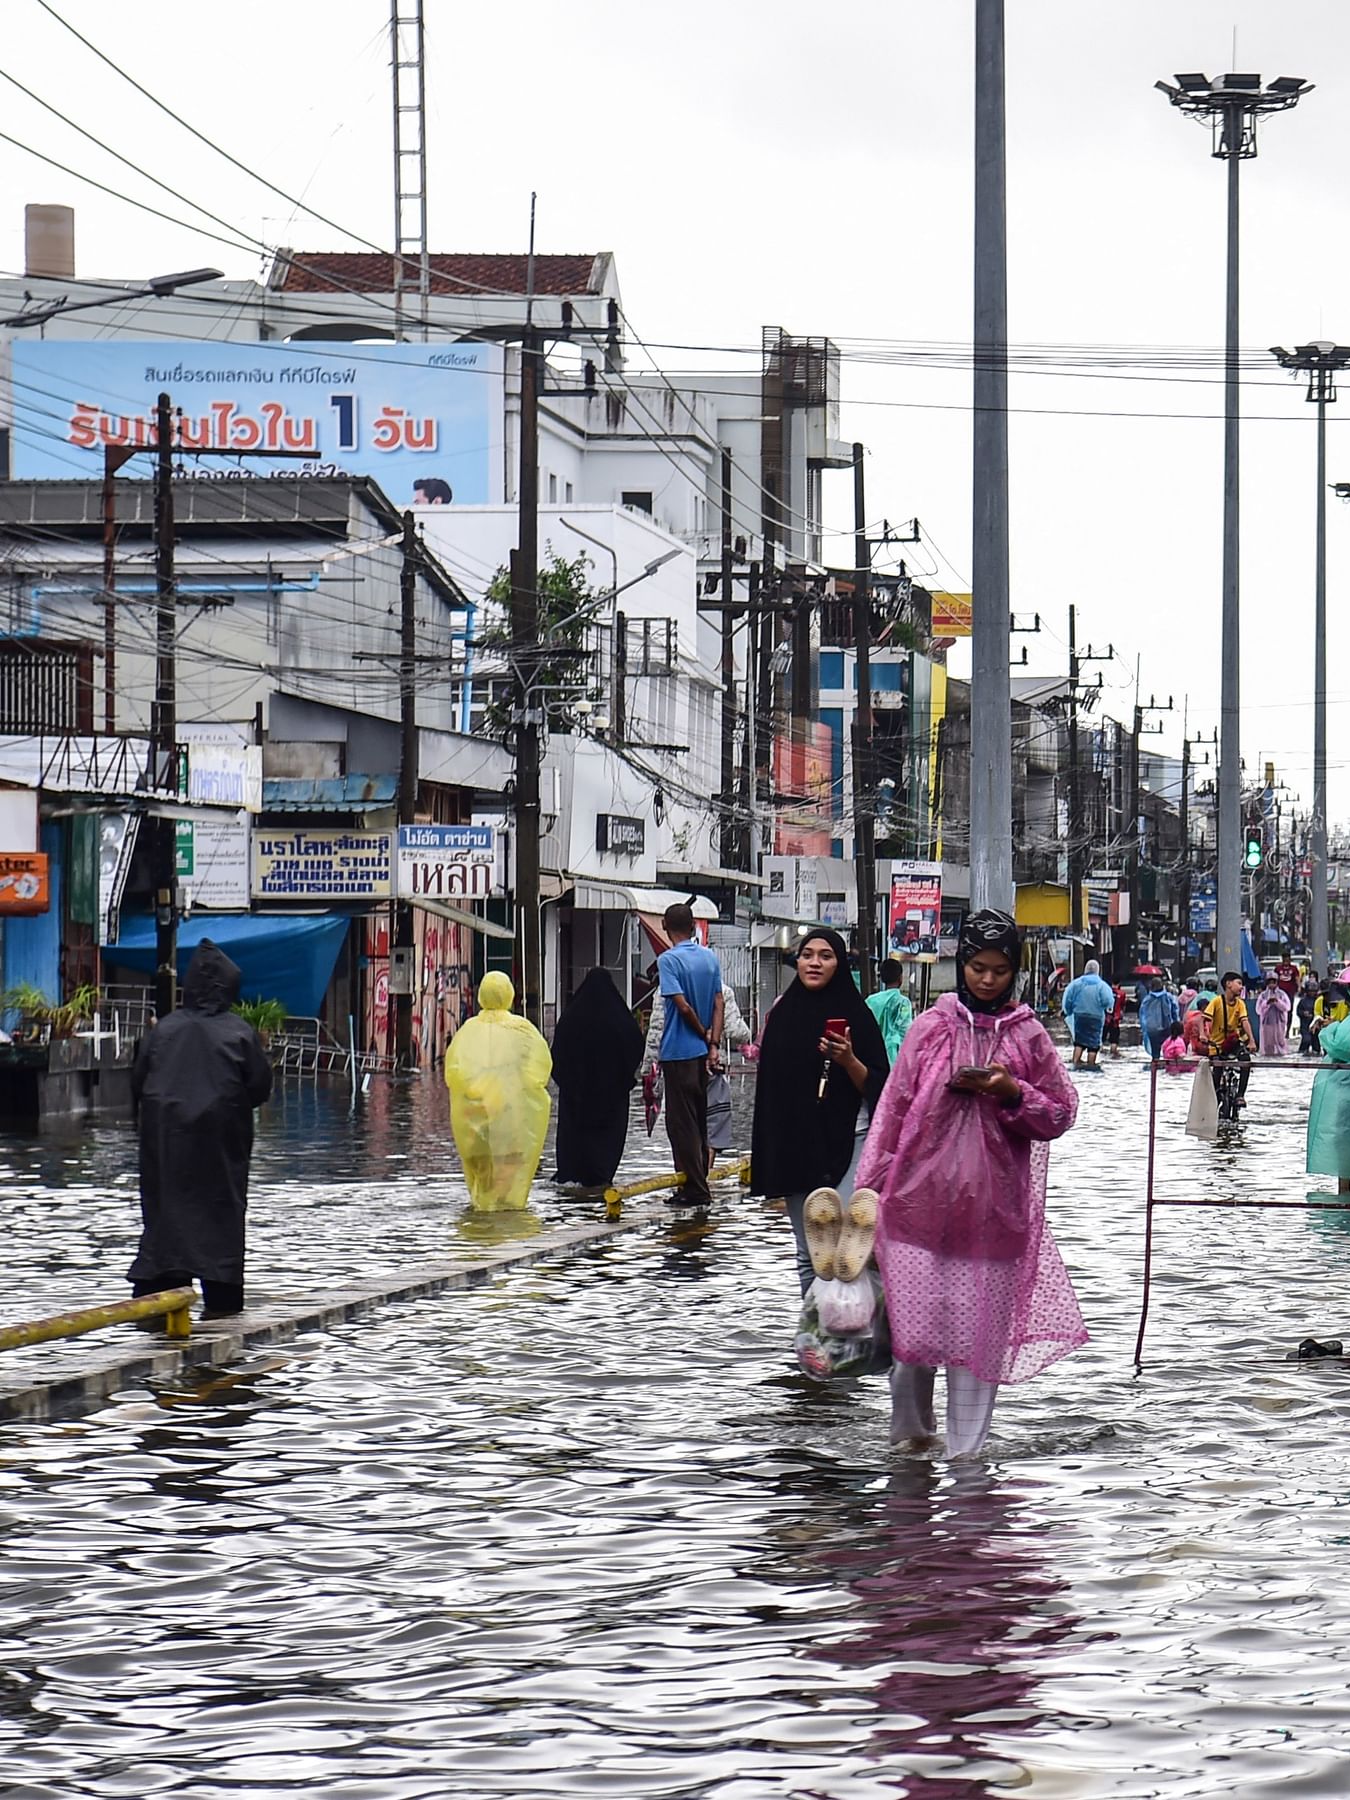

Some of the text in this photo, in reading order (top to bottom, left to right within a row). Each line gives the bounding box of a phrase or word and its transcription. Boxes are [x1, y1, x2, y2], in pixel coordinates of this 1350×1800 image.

[144, 366, 357, 385] สินเชื่อรถแลกเงิน ทีทีบีไดรฟ์
[331, 395, 358, 448] 1
[372, 407, 435, 449] วัน
[259, 832, 338, 856] นราโลหะ
[404, 828, 487, 846] ไม้อัด ตาข่าย
